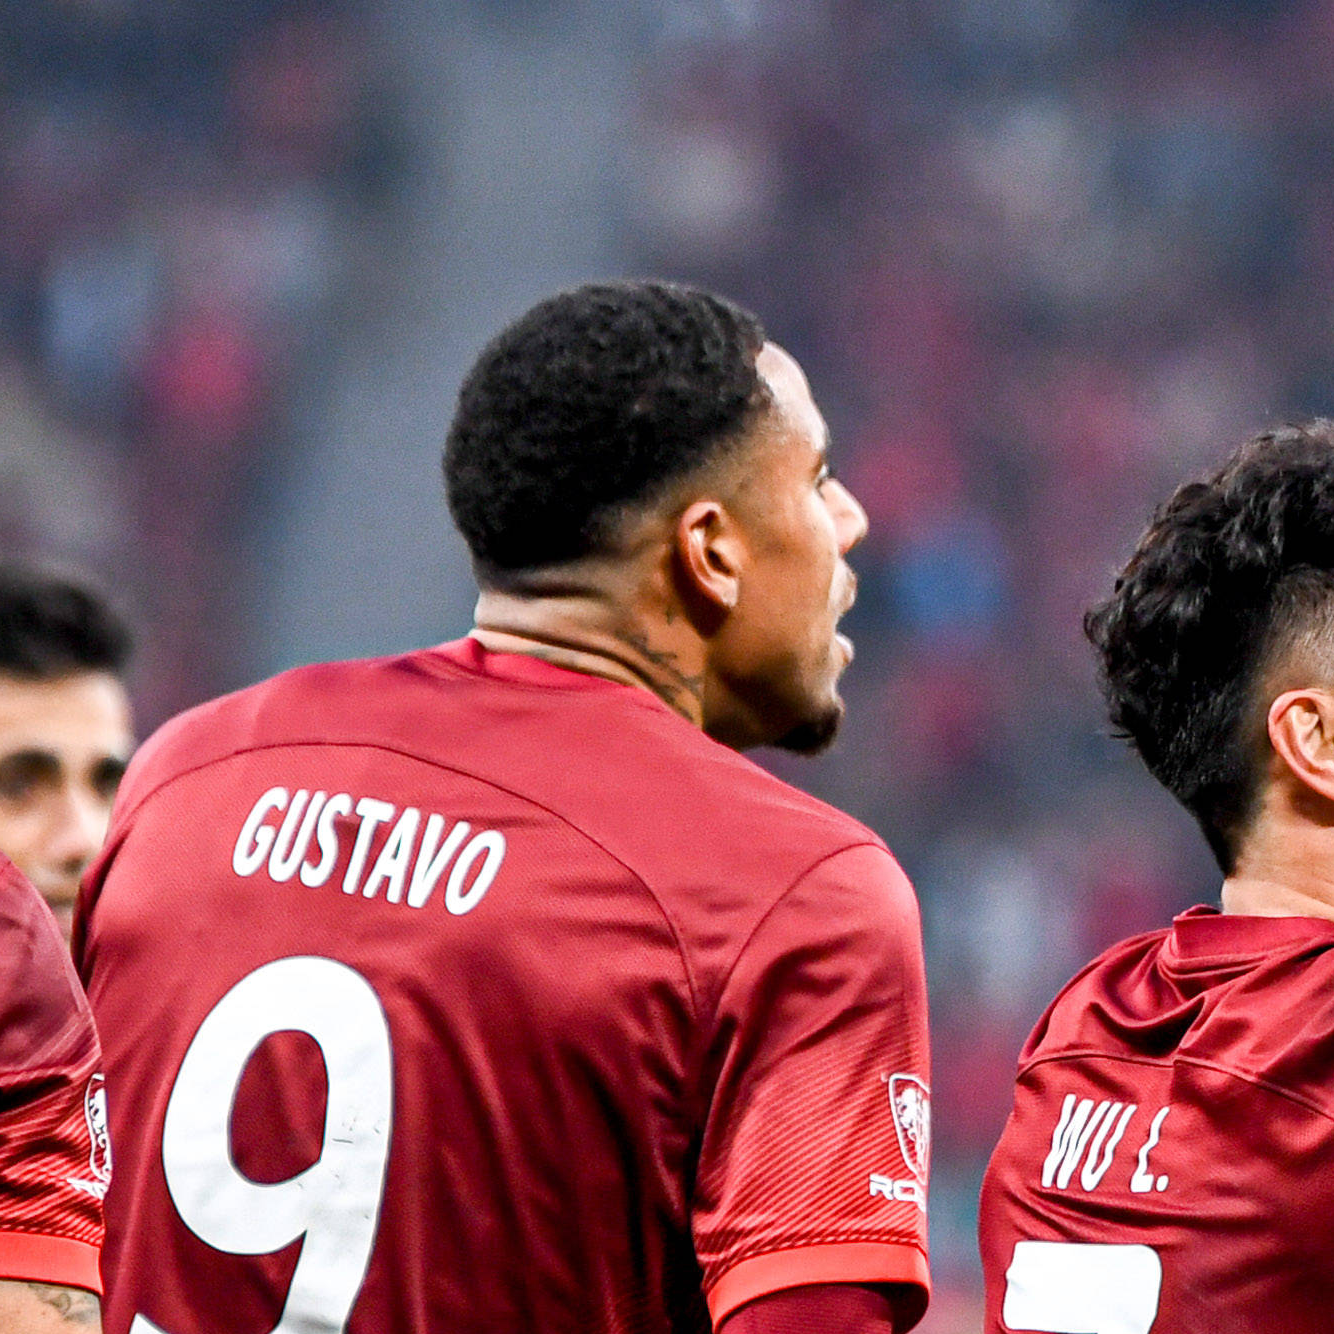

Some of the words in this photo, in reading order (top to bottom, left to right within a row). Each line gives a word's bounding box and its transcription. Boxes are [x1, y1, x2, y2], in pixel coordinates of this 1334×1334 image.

[232, 786, 507, 916] GUSTAVO
[1041, 1093, 1137, 1192] WU
[1130, 1106, 1170, 1193] L.
